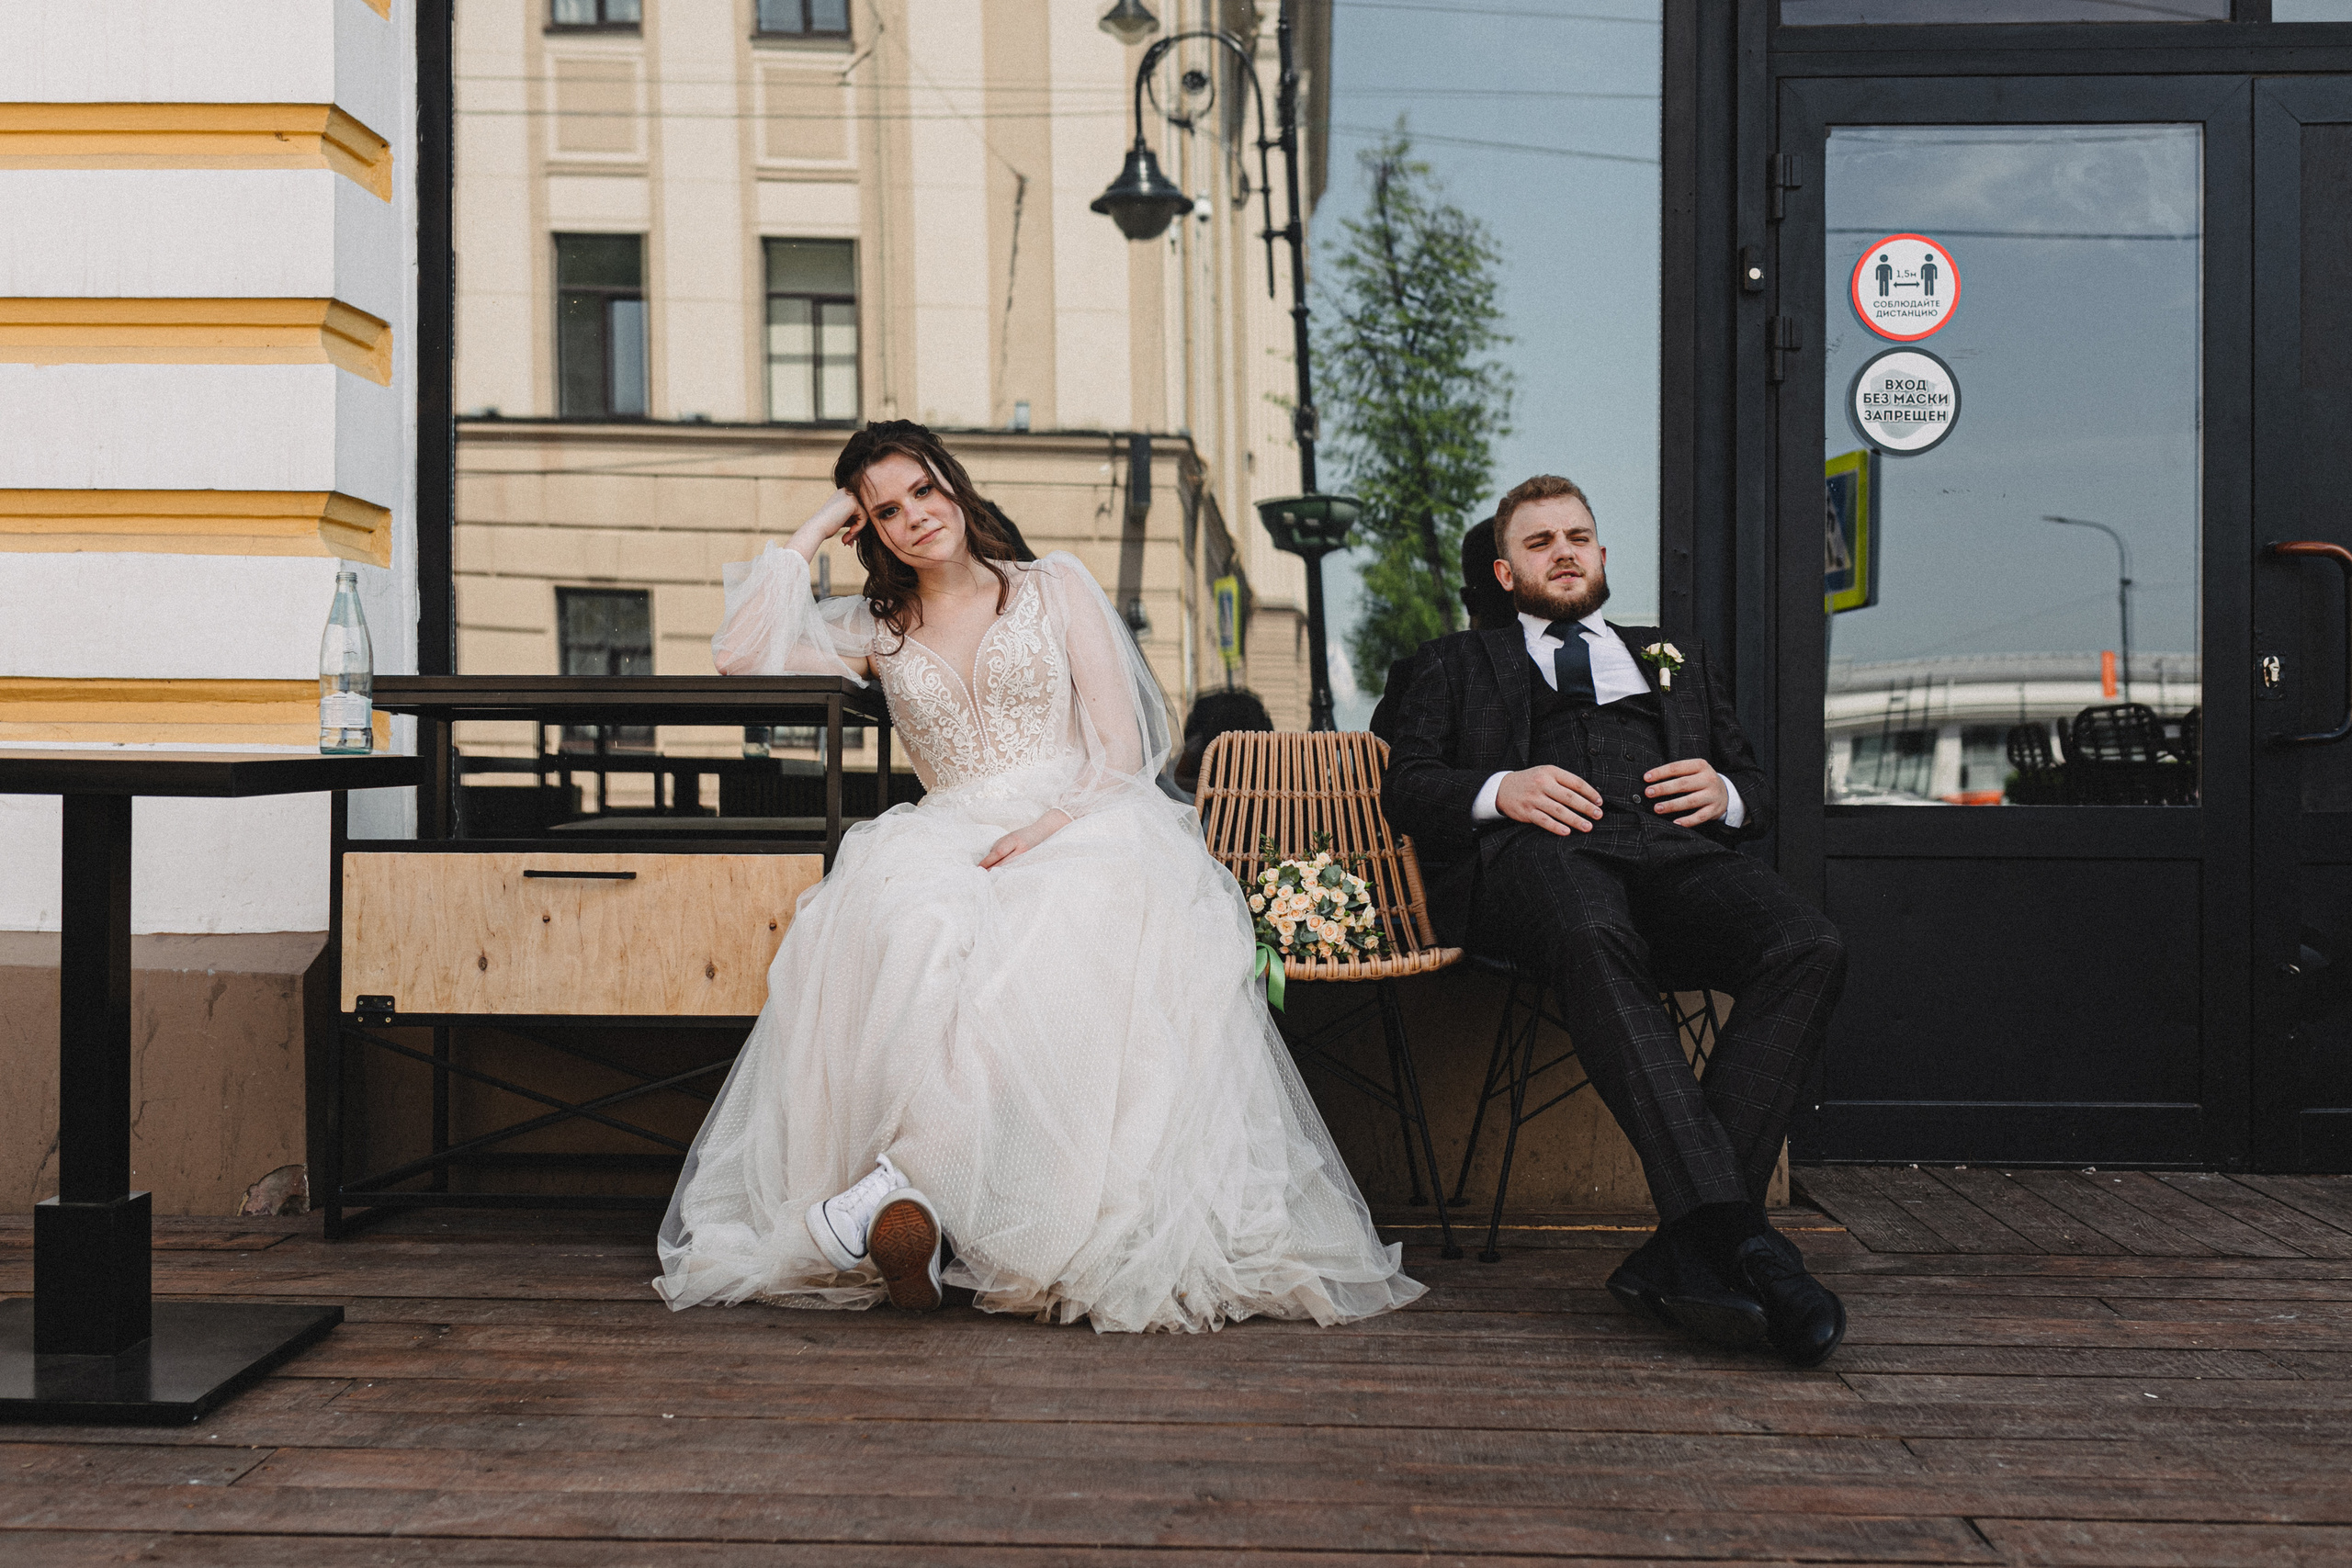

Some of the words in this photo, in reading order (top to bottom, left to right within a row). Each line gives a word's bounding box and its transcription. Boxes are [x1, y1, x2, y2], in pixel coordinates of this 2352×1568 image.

[1873, 299, 1940, 309] СОБЛЮДАЙТЕ
[1876, 310, 1938, 318] ДИСТАНЦИЮ
[1885, 379, 1927, 391] ВХОД
[1863, 393, 1889, 404] БЕЗ
[1894, 393, 1949, 404] МАСКИ
[1864, 410, 1946, 422] ЗАПРЕЩЕН
